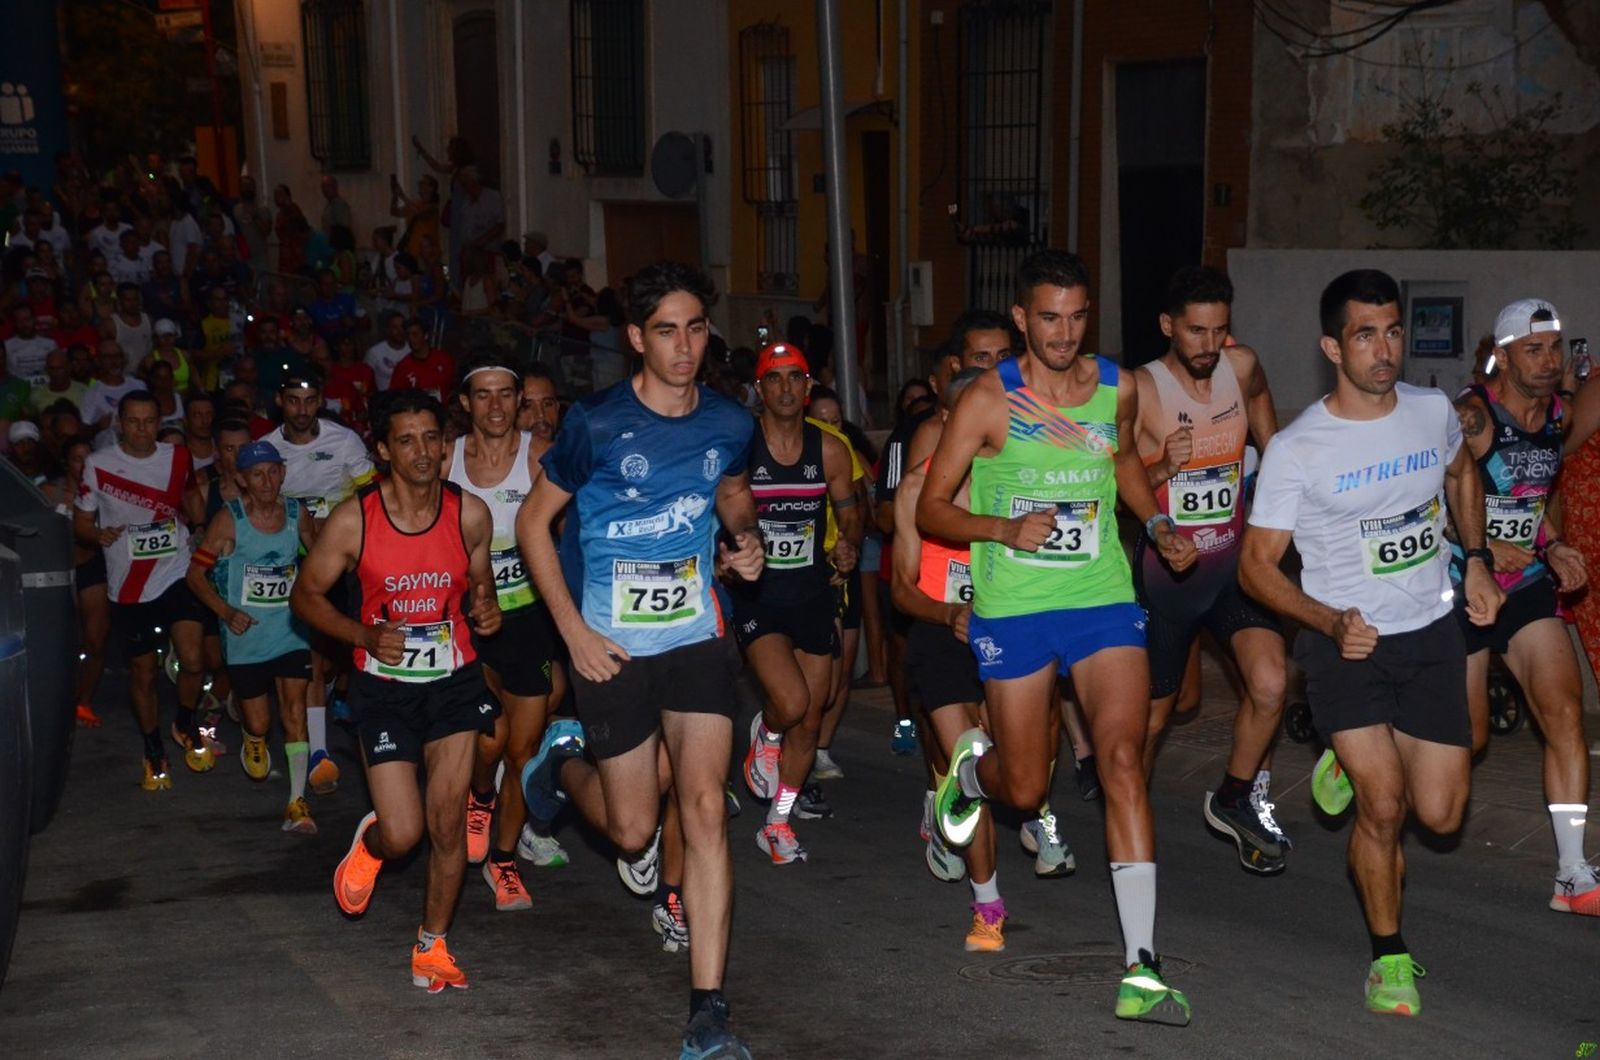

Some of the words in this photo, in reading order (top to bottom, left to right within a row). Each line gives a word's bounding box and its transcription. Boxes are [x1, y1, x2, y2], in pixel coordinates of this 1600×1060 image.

[1015, 499, 1033, 511] VIII
[1183, 488, 1232, 512] 810
[1487, 518, 1533, 539] 536
[136, 534, 171, 551] 782
[767, 540, 805, 557] 197
[1378, 526, 1434, 564] 696
[617, 562, 636, 574] VIII
[253, 581, 287, 597] 370
[385, 572, 452, 592] SAYMA
[392, 597, 437, 613] NIJAR
[628, 586, 687, 611] 752
